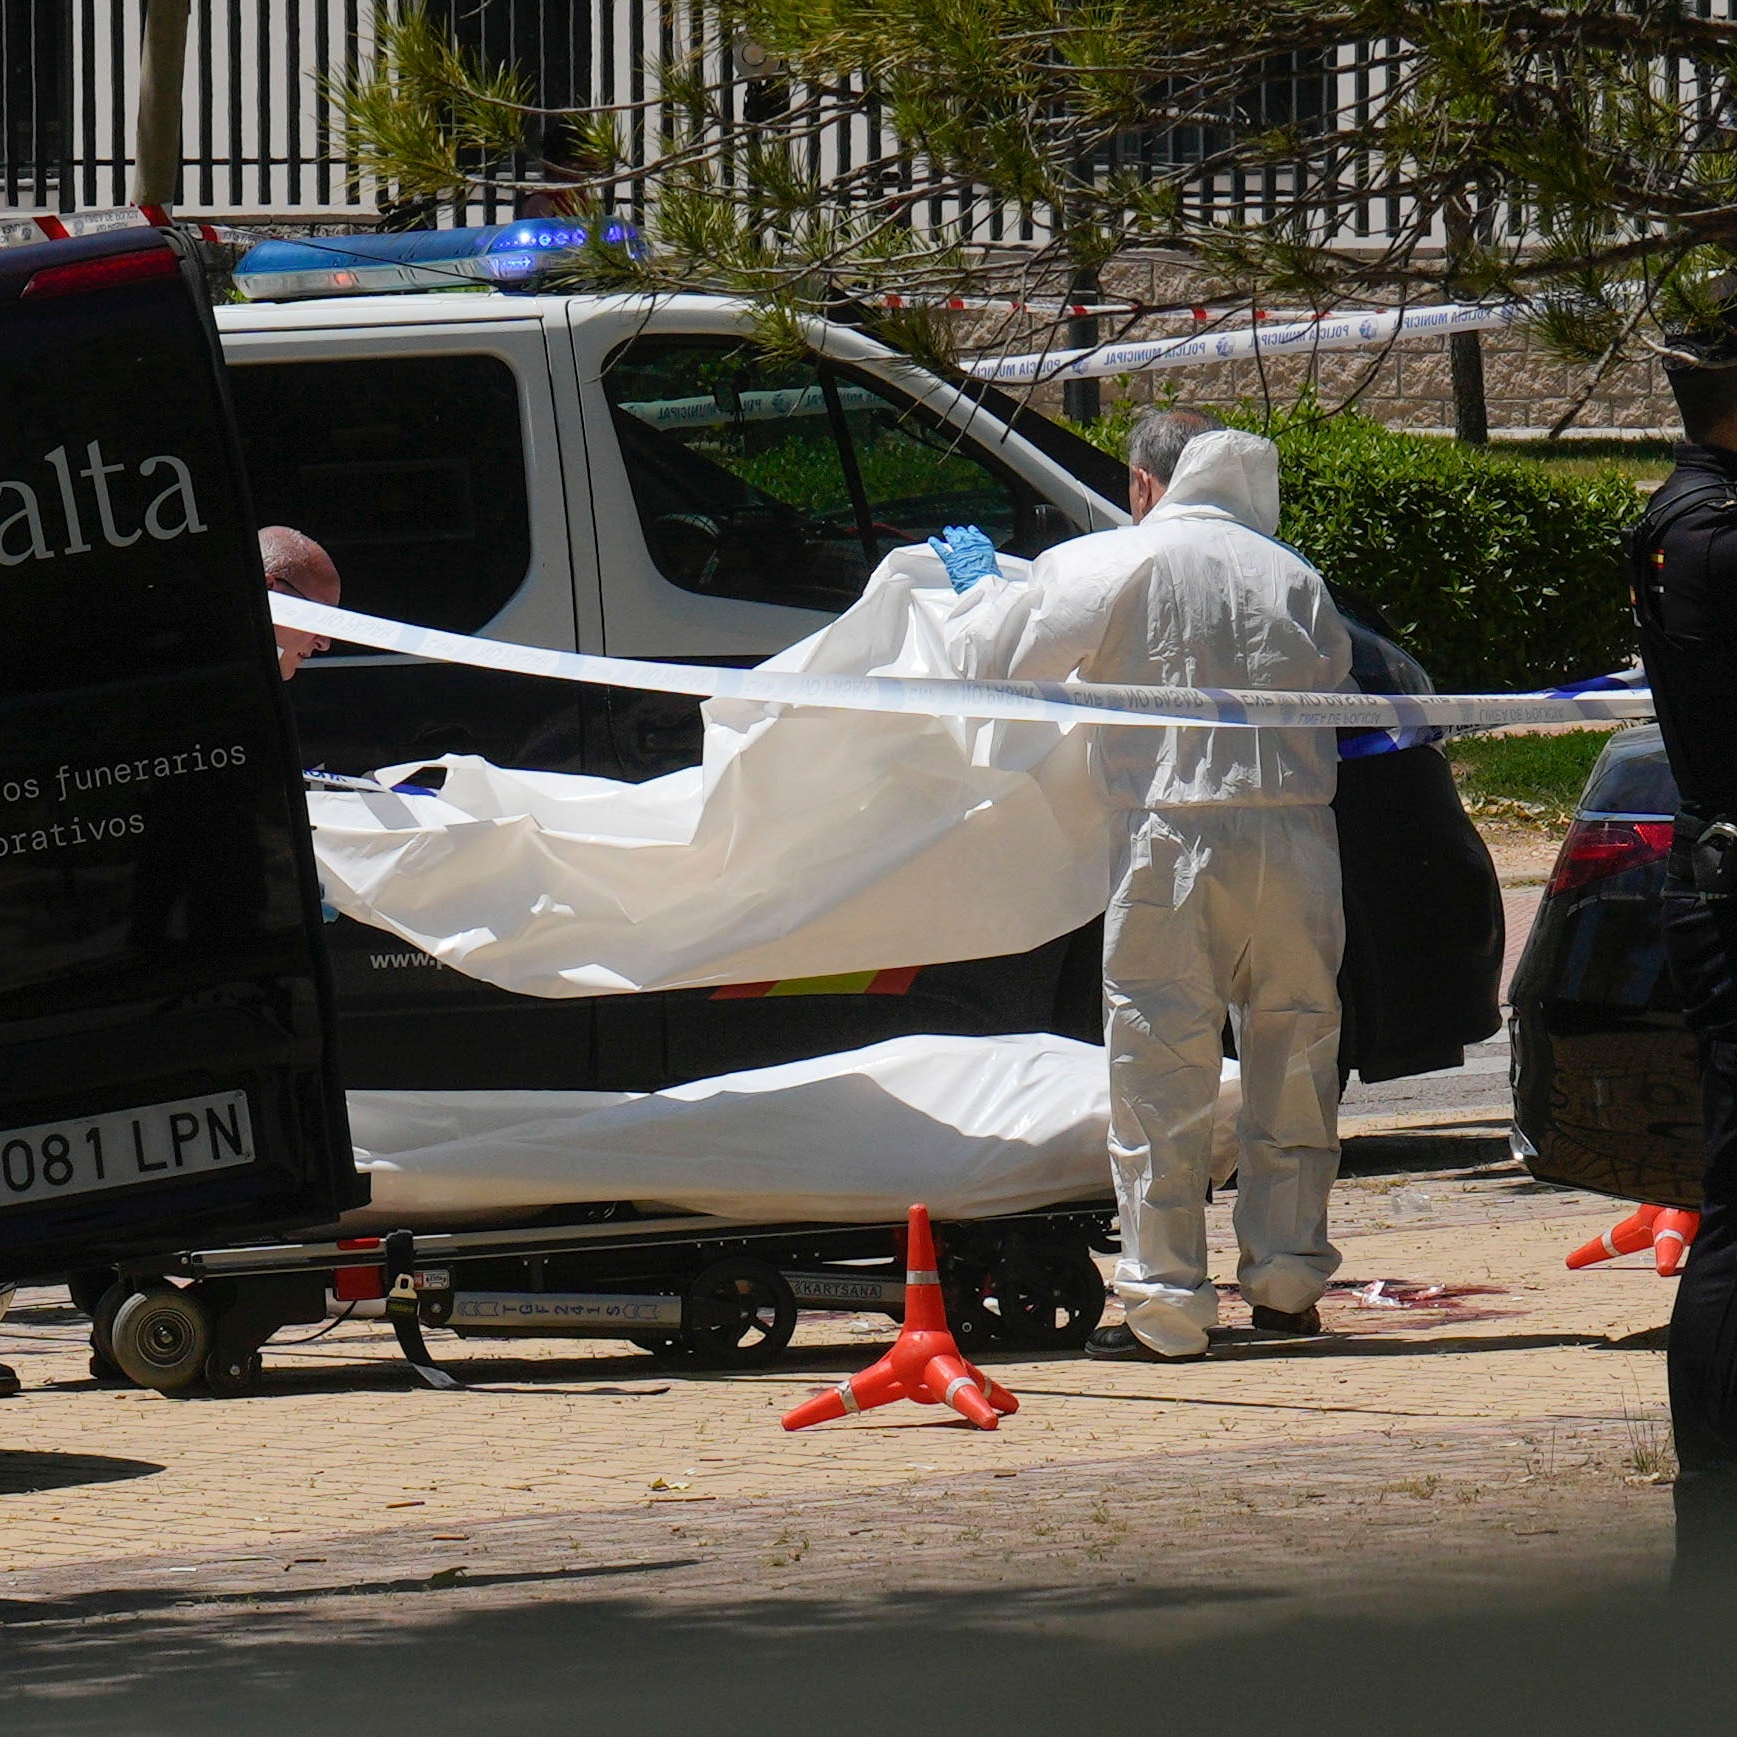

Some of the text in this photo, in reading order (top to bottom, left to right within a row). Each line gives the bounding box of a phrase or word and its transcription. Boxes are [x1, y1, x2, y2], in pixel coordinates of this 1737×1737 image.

[55, 744, 246, 801] funerarios
[134, 1103, 244, 1174] LPN
[804, 1283, 878, 1298] KARTSANA
